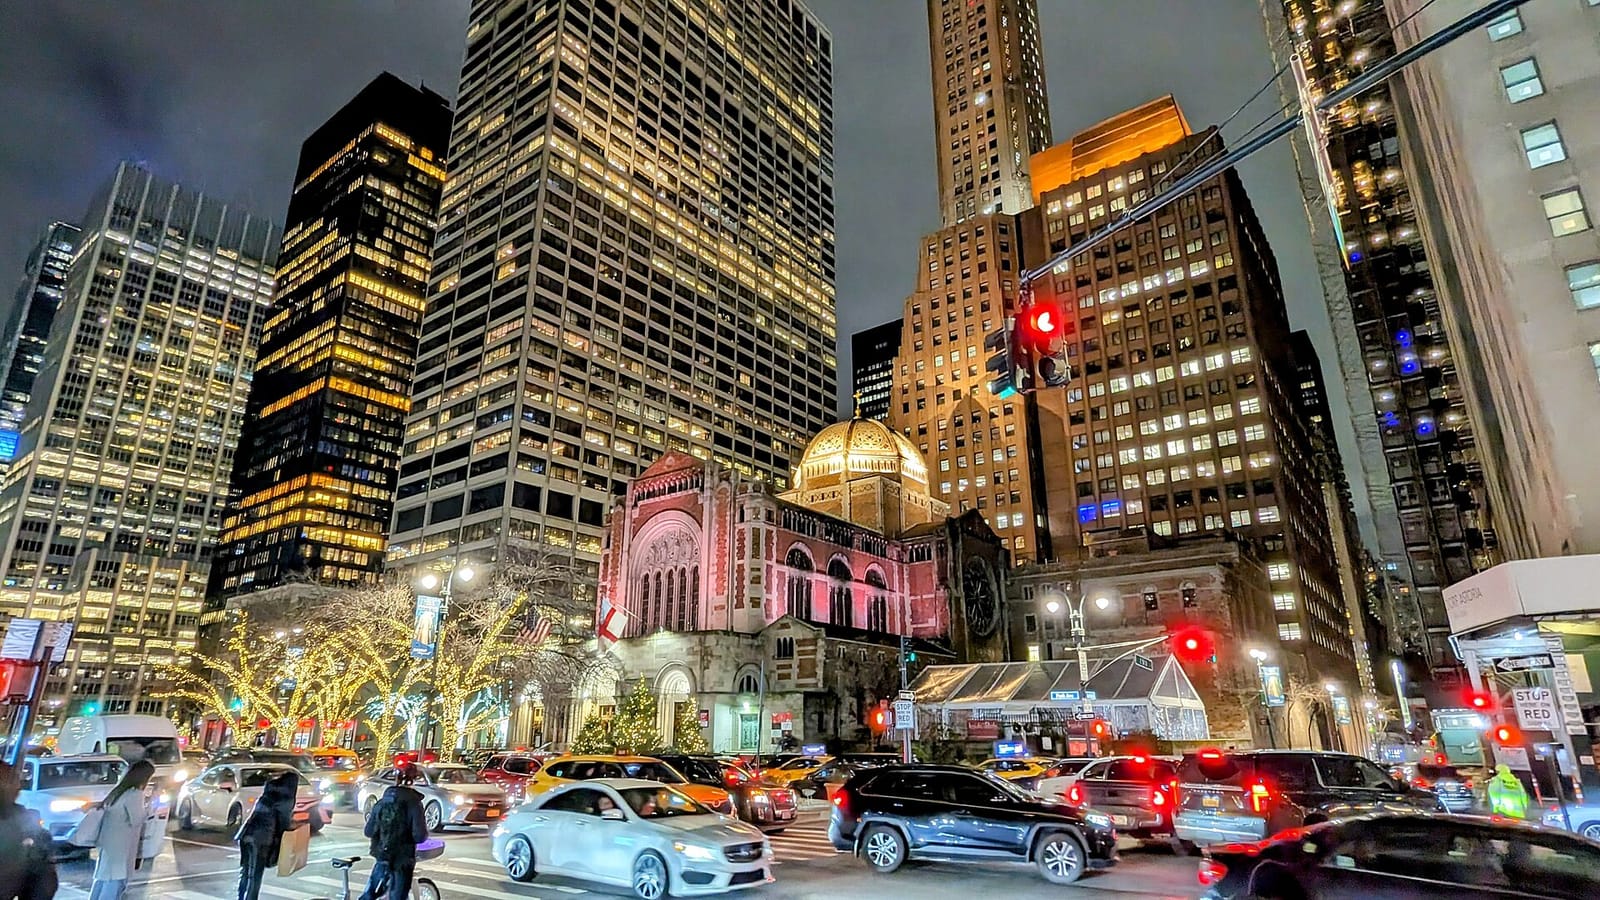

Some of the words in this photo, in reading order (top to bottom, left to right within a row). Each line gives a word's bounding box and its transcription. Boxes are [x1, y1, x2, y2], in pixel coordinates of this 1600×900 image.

[1503, 659, 1520, 668] ONE
[1516, 690, 1549, 701] STOP
[1524, 709, 1551, 719] RED
